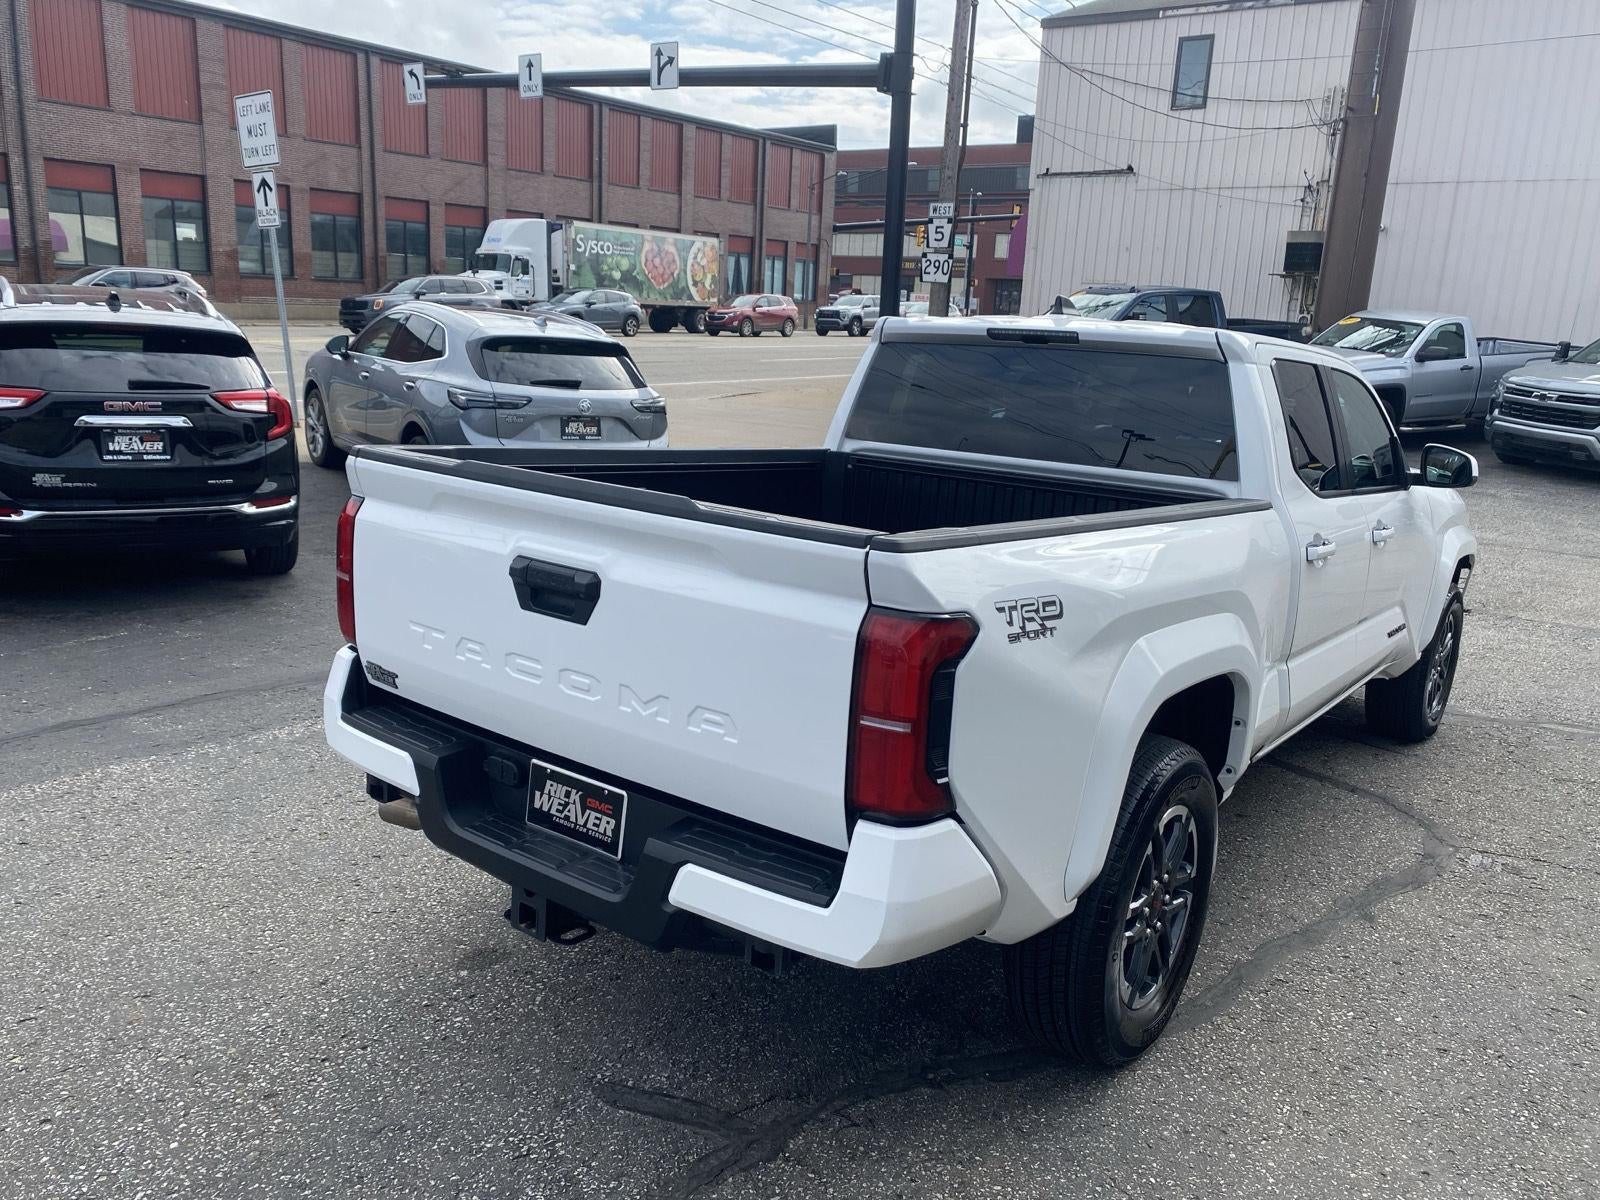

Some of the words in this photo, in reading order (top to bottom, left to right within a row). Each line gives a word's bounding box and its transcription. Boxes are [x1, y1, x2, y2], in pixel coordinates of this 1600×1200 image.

[522, 84, 539, 93] ONLY
[238, 104, 253, 117] LEFT
[255, 101, 271, 115] LANE
[246, 122, 267, 138] MUST
[244, 147, 260, 160] TURN
[261, 144, 276, 157] LEFT
[258, 208, 277, 218] BLACK
[932, 205, 952, 215] WEST
[934, 226, 945, 242] 5
[576, 234, 613, 256] Sysco
[923, 259, 950, 276] 290
[103, 401, 162, 412] GMC
[108, 442, 164, 451] WEAVER
[114, 435, 140, 443] RICK
[994, 594, 1064, 632] TRD
[1007, 626, 1058, 644] SPORT
[408, 620, 740, 744] TACOMA
[544, 780, 583, 805] RICK
[534, 790, 616, 838] WEAVER
[586, 798, 613, 815] GMC
[552, 816, 574, 829] FAMOUS
[576, 824, 587, 832] FOR
[588, 828, 612, 843] SERVICE
